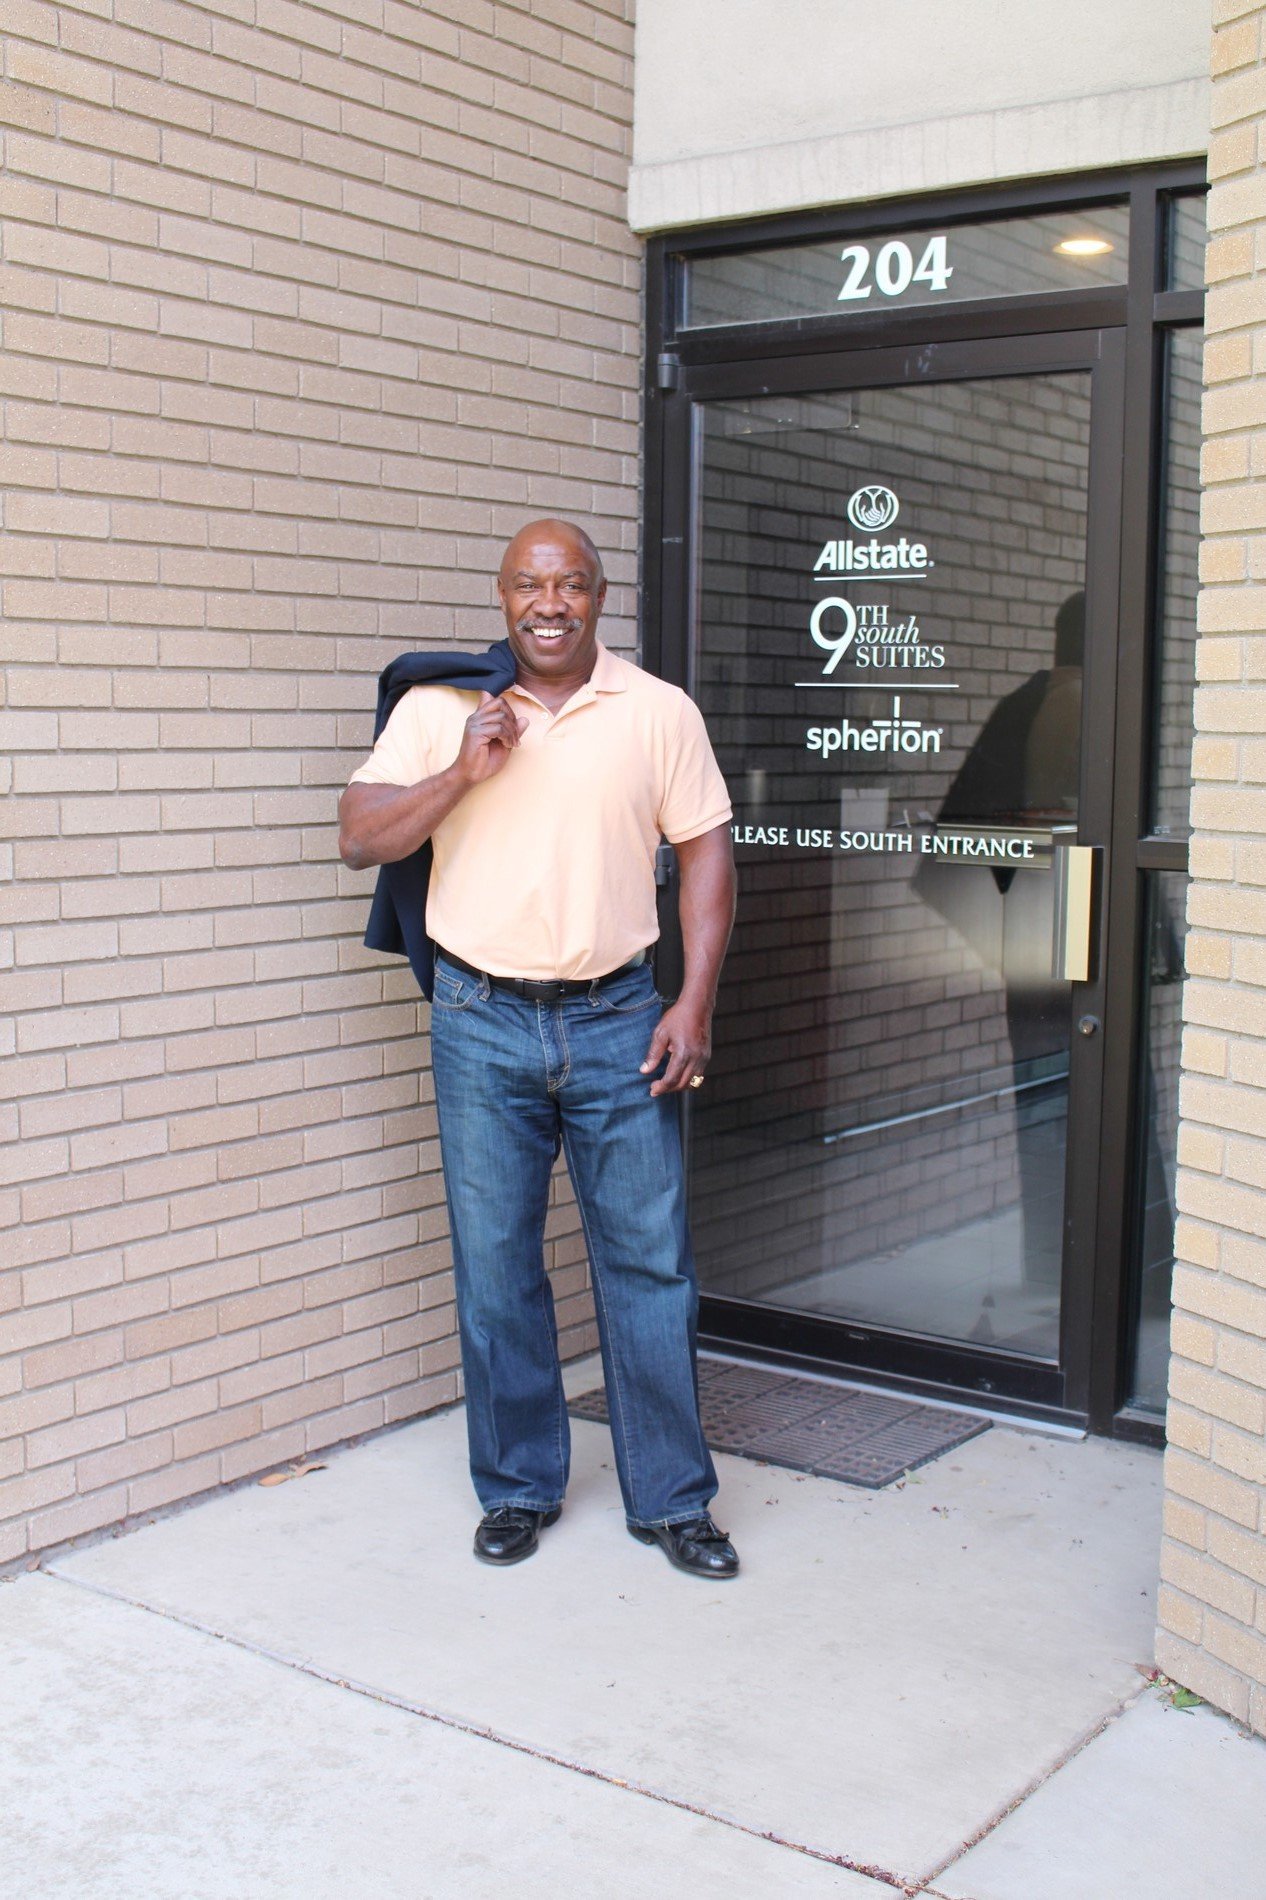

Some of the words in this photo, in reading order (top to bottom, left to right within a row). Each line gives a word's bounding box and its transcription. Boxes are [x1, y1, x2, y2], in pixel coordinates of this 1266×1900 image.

[837, 236, 953, 301] 204
[813, 538, 928, 571] Allstate
[855, 616, 920, 644] south
[856, 645, 945, 668] SUITES
[806, 708, 941, 759] spherion
[732, 825, 790, 846] LEASE
[796, 828, 834, 848] USE
[840, 830, 913, 853] SOUTH
[921, 834, 1035, 859] ENTRANCE
